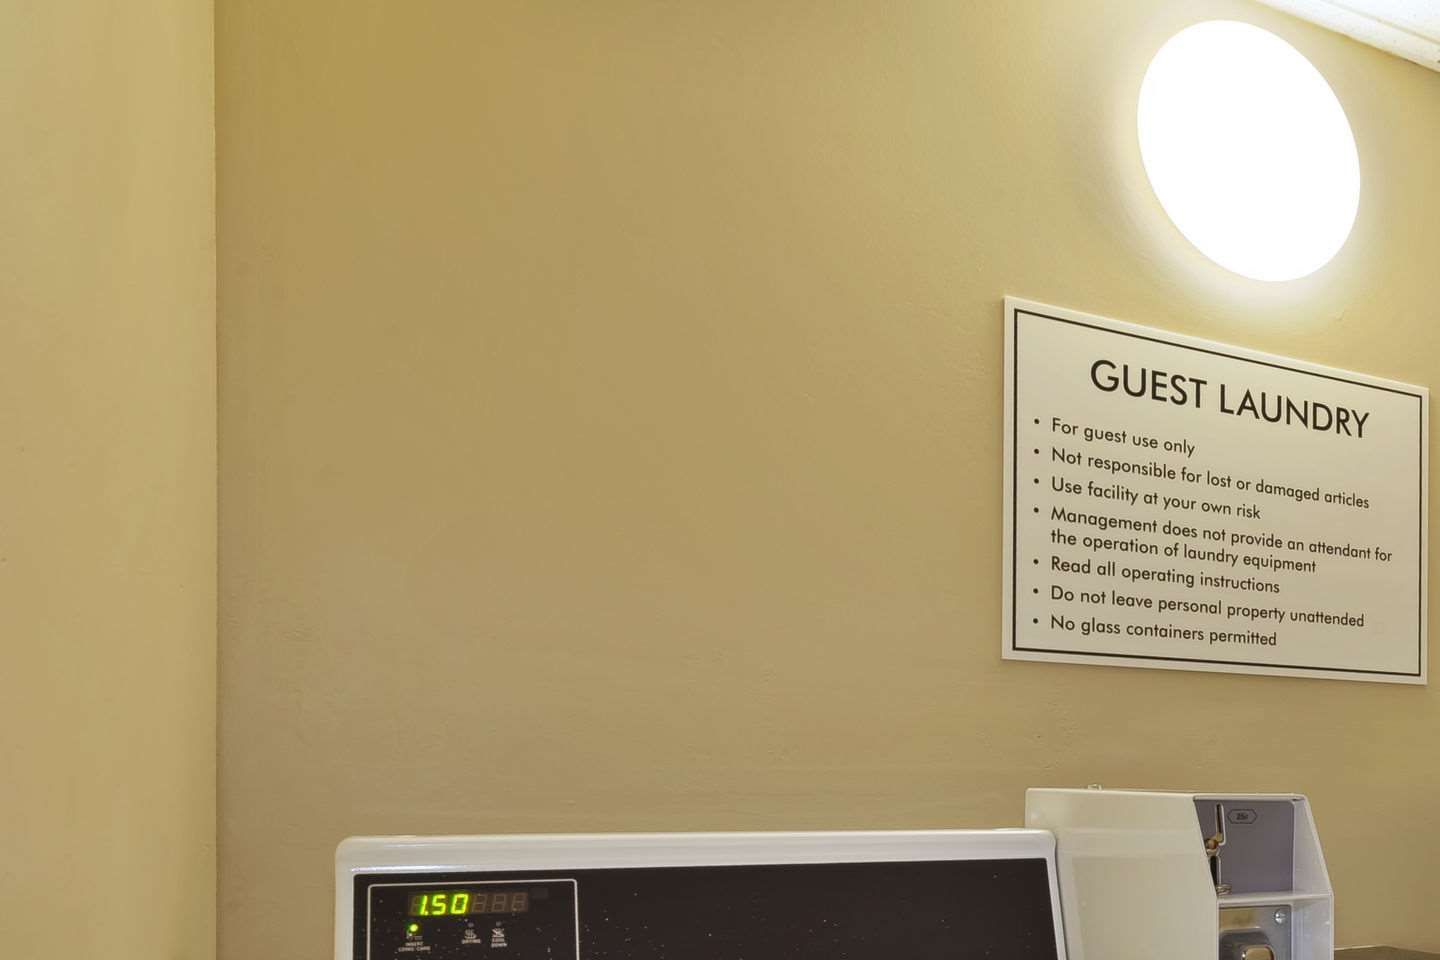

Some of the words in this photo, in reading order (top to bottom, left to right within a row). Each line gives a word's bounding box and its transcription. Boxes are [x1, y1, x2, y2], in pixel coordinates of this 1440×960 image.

[1090, 359, 1208, 409] GUEST
[1219, 383, 1371, 439] LAUNDRY
[1051, 416, 1080, 437] For
[1083, 426, 1128, 445] guest
[1132, 435, 1159, 450] use
[1163, 438, 1196, 459] only
[1051, 445, 1083, 467] Not
[1087, 456, 1177, 481] responsible
[1180, 465, 1203, 484] for
[1206, 469, 1233, 489] lost
[1235, 479, 1252, 492] or
[1255, 478, 1320, 503] damaged
[1323, 491, 1370, 509] articles
[1051, 475, 1083, 496] Use
[1086, 480, 1140, 507] facility
[1143, 491, 1159, 507] at
[1161, 495, 1198, 511] your
[1200, 501, 1232, 516] own
[1236, 503, 1262, 520] risk
[1050, 505, 1158, 534] Management
[1162, 519, 1199, 539] does
[1202, 528, 1227, 543] not
[1230, 532, 1284, 549] provide
[1286, 540, 1305, 552] an
[1308, 540, 1372, 560] attendant
[1374, 546, 1393, 562] for
[1050, 527, 1078, 547] the
[1082, 536, 1159, 556] operation
[1163, 541, 1180, 558] of
[1183, 542, 1239, 568] laundry
[1242, 553, 1317, 574] equipment
[1051, 555, 1092, 575] Read
[1096, 560, 1116, 577] all
[1120, 567, 1195, 589] operating
[1199, 570, 1281, 594] instructions
[1050, 584, 1075, 602] Do
[1080, 590, 1107, 605] not
[1111, 589, 1153, 609] leave
[1157, 599, 1222, 616] personal
[1226, 605, 1286, 625] property
[1289, 610, 1365, 628] unattended
[1050, 613, 1076, 632] No
[1080, 616, 1121, 636] glass
[1125, 623, 1205, 641] containers
[1209, 628, 1277, 647] permitted
[418, 893, 470, 916] 1.50
